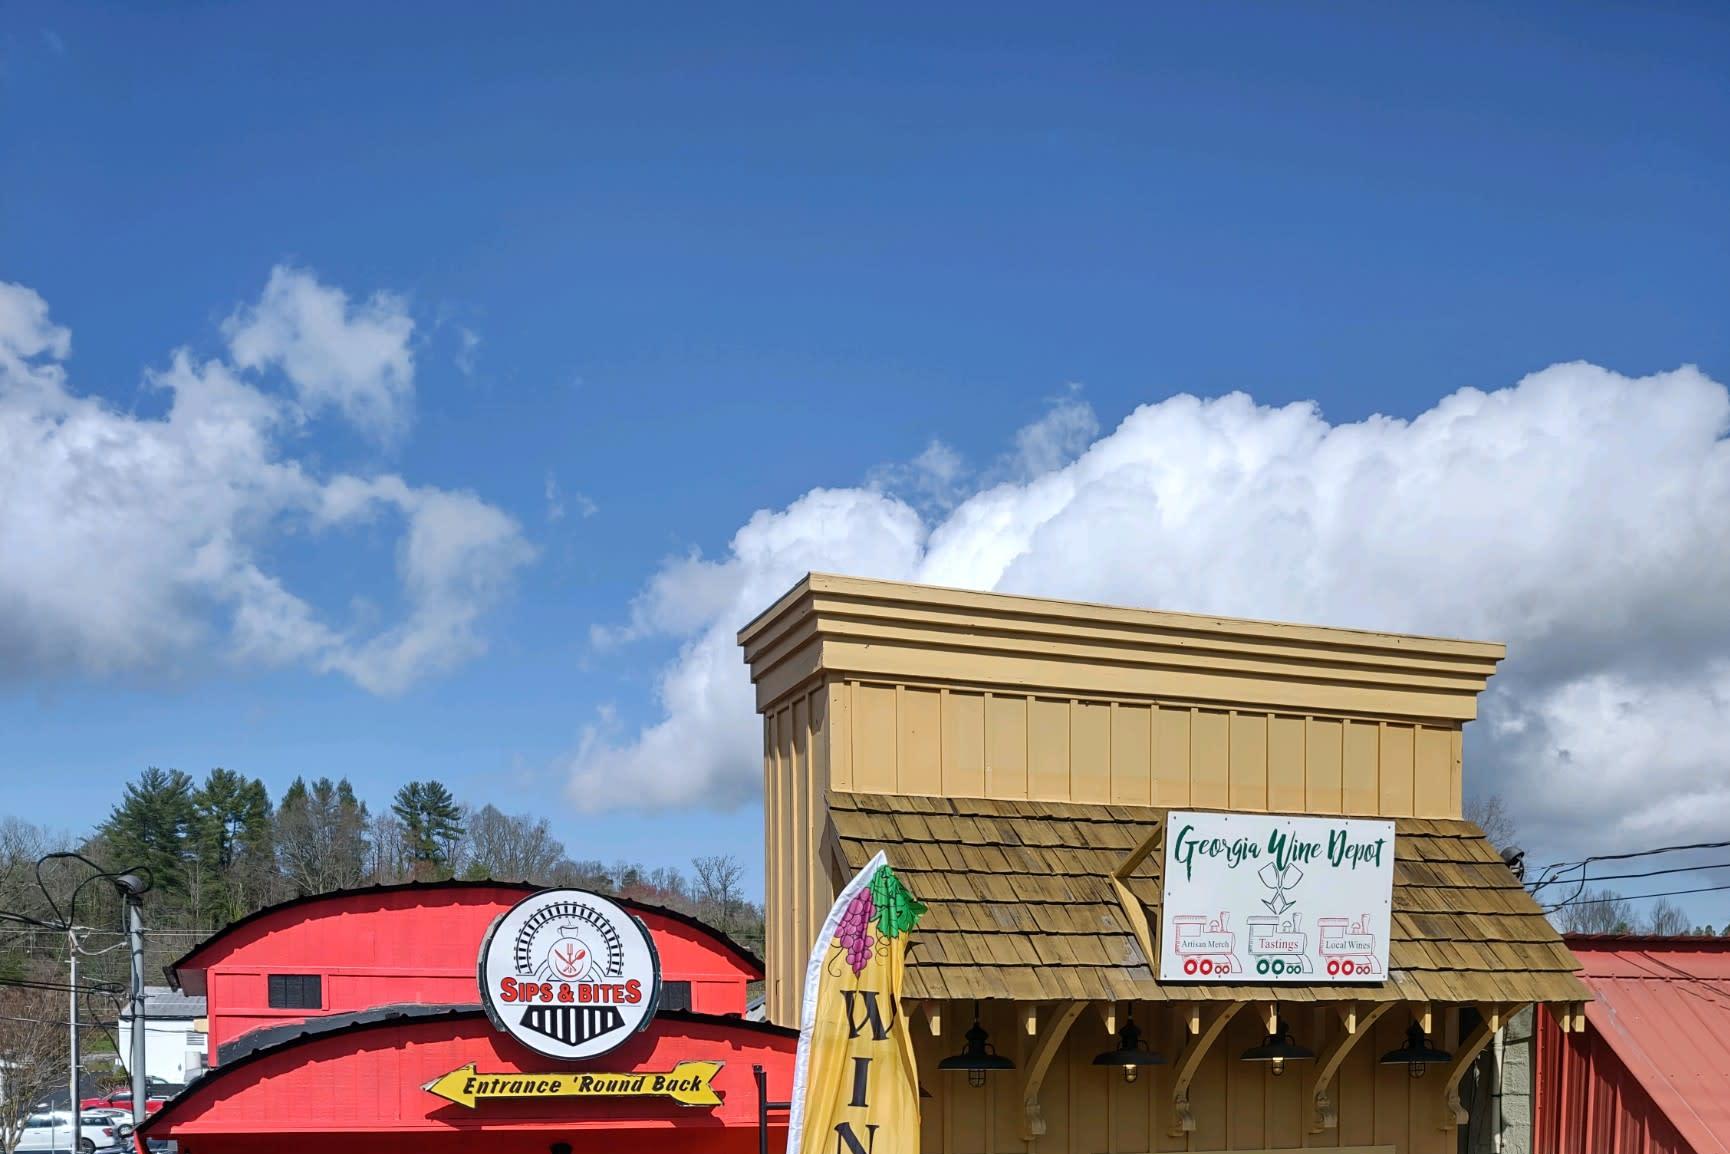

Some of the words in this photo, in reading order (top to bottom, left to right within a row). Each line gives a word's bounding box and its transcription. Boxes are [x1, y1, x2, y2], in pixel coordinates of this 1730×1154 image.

[1174, 824, 1261, 883] Georgia
[1267, 828, 1322, 871] Wine
[1328, 829, 1387, 870] Depot
[1181, 939, 1206, 948] Artisan
[1208, 939, 1229, 948] Merch
[1259, 937, 1298, 951] Tastings
[1325, 940, 1347, 949] Local
[1347, 940, 1371, 950] Wines
[500, 977, 553, 1003] SIPS
[558, 983, 574, 1002] &
[462, 1076, 562, 1095] Entrance
[651, 1075, 701, 1092] Back
